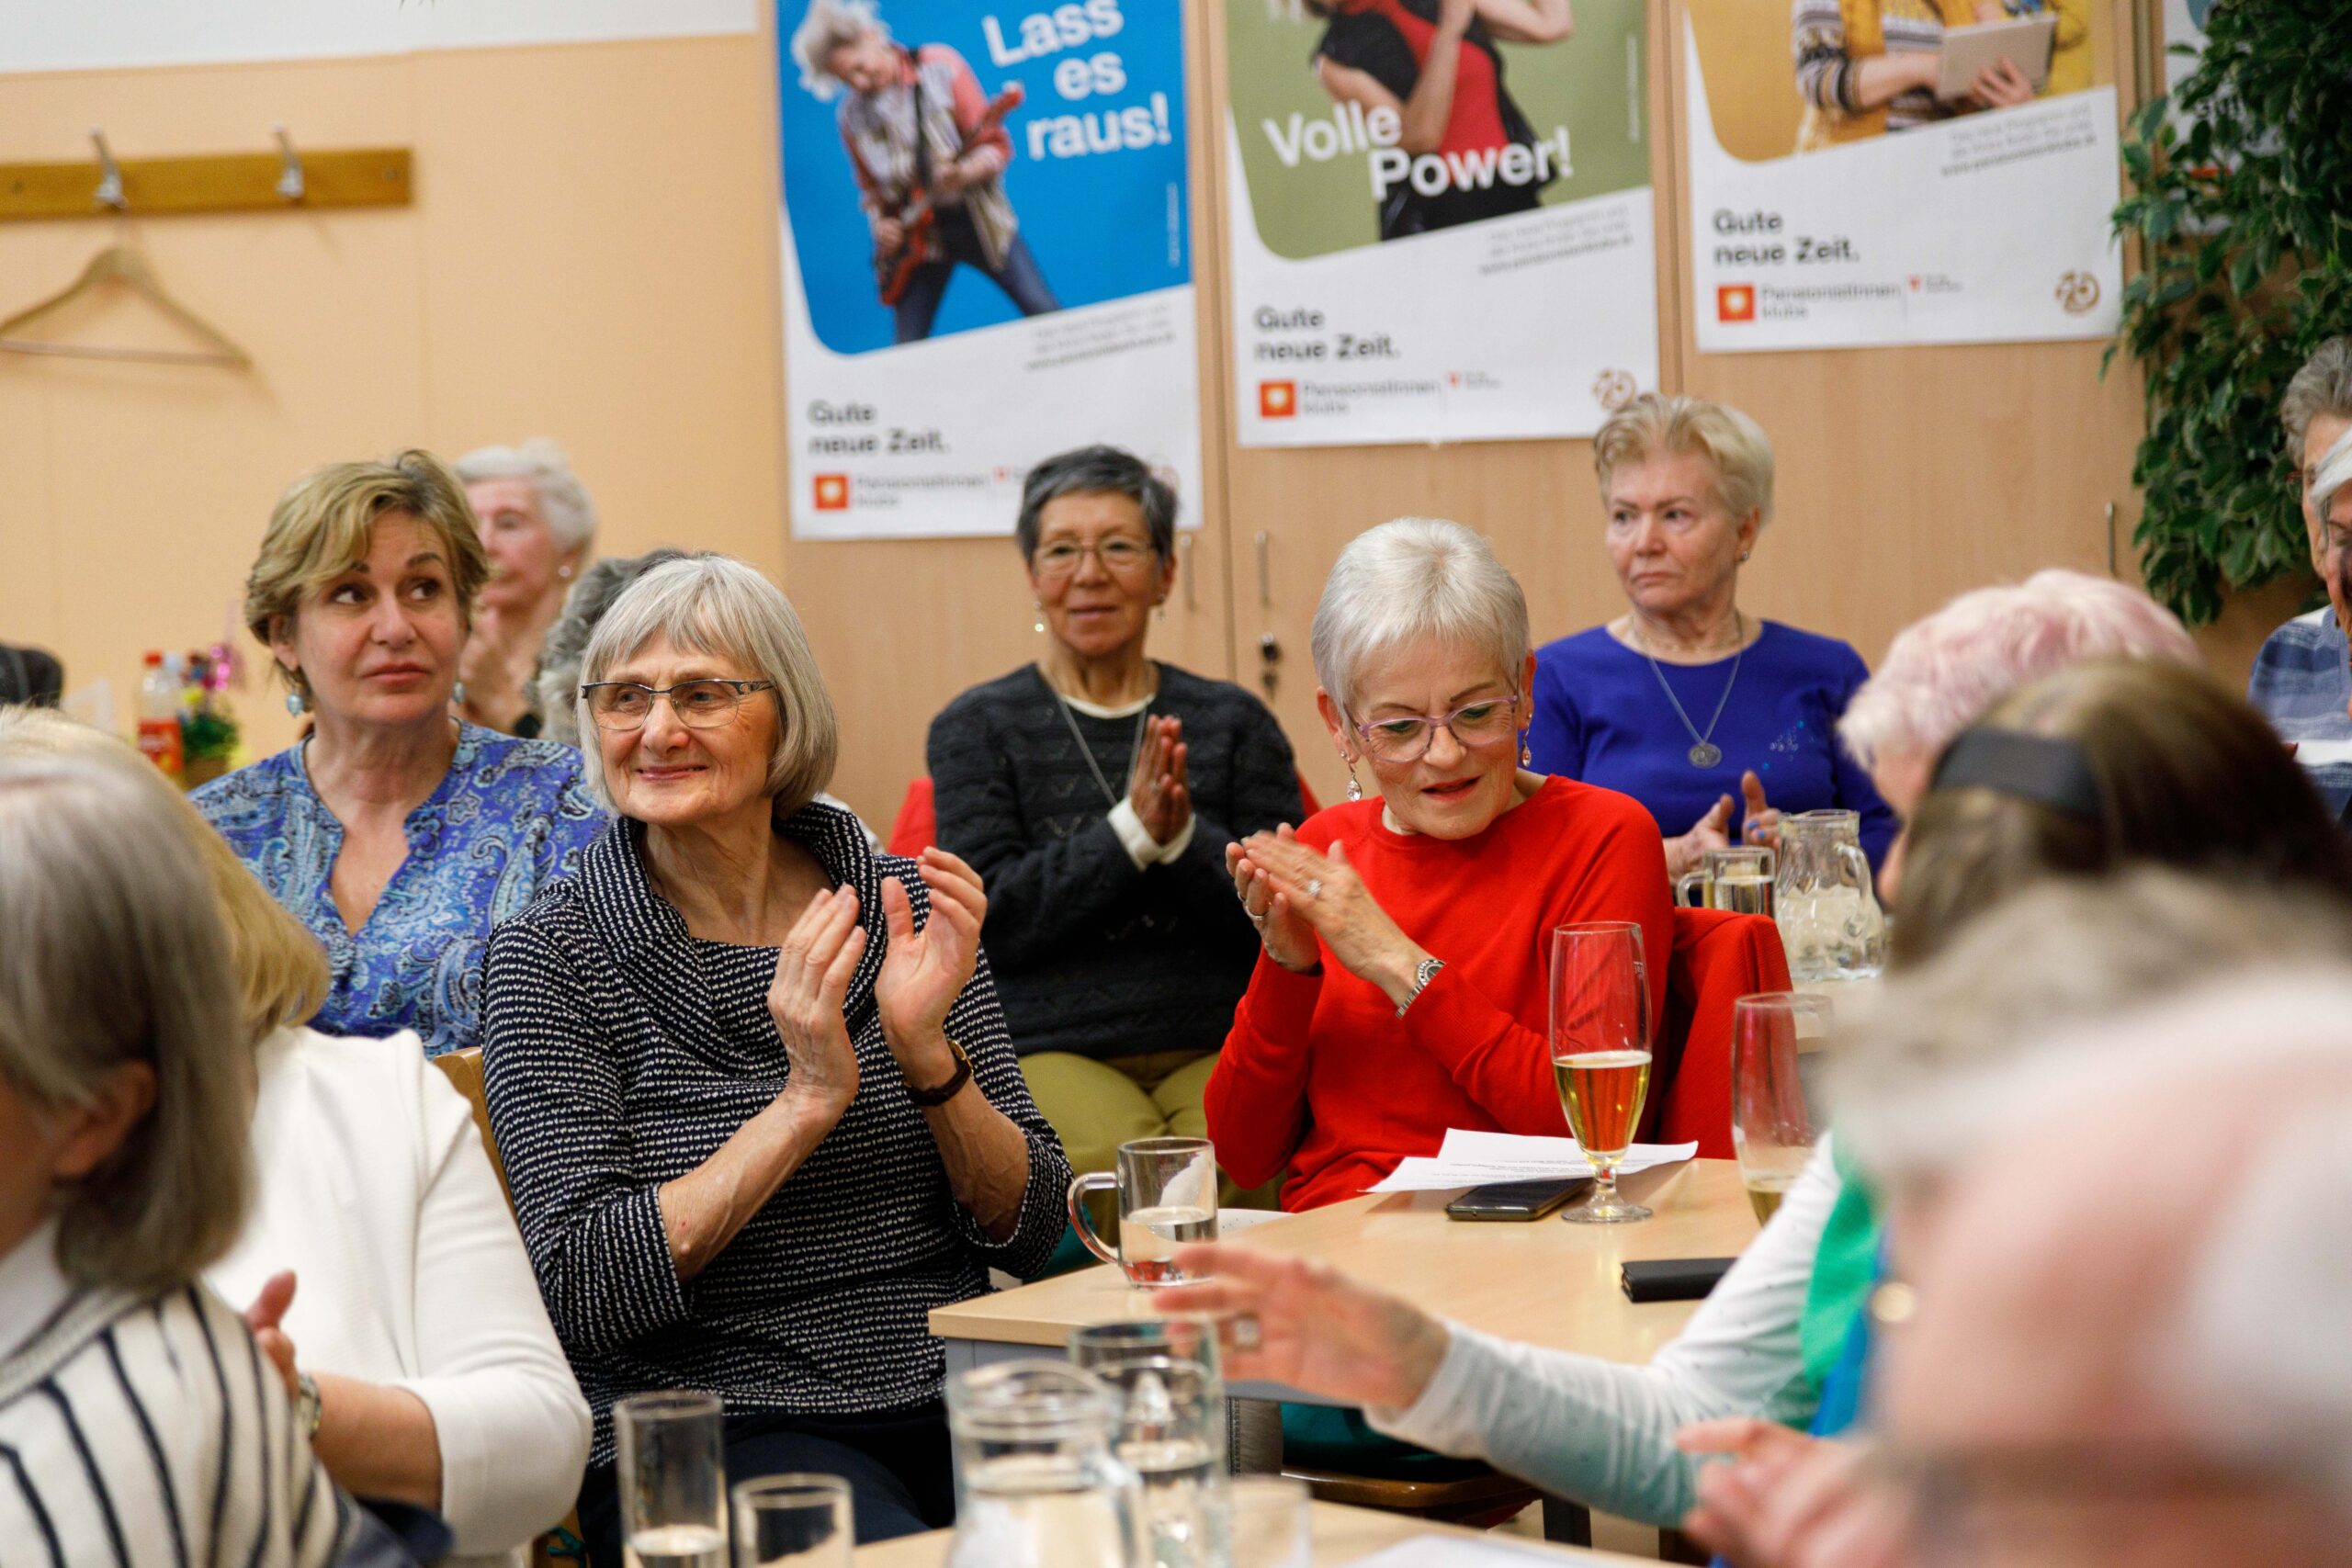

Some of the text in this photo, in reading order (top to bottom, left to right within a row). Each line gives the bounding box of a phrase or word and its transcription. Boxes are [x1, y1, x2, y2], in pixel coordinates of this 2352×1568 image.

[982, 0, 1124, 67] Lass
[1053, 52, 1127, 100] es
[1026, 91, 1171, 160] raus!
[1263, 100, 1402, 167] Volle
[1368, 126, 1573, 201] Power!
[1713, 209, 1783, 233] Gute
[1714, 236, 1860, 264] neue Zeit.
[1255, 306, 1324, 331] Gute
[1255, 333, 1401, 360] neue Zeit.
[808, 400, 876, 425] Gute
[808, 428, 949, 456] neue Zeit.
